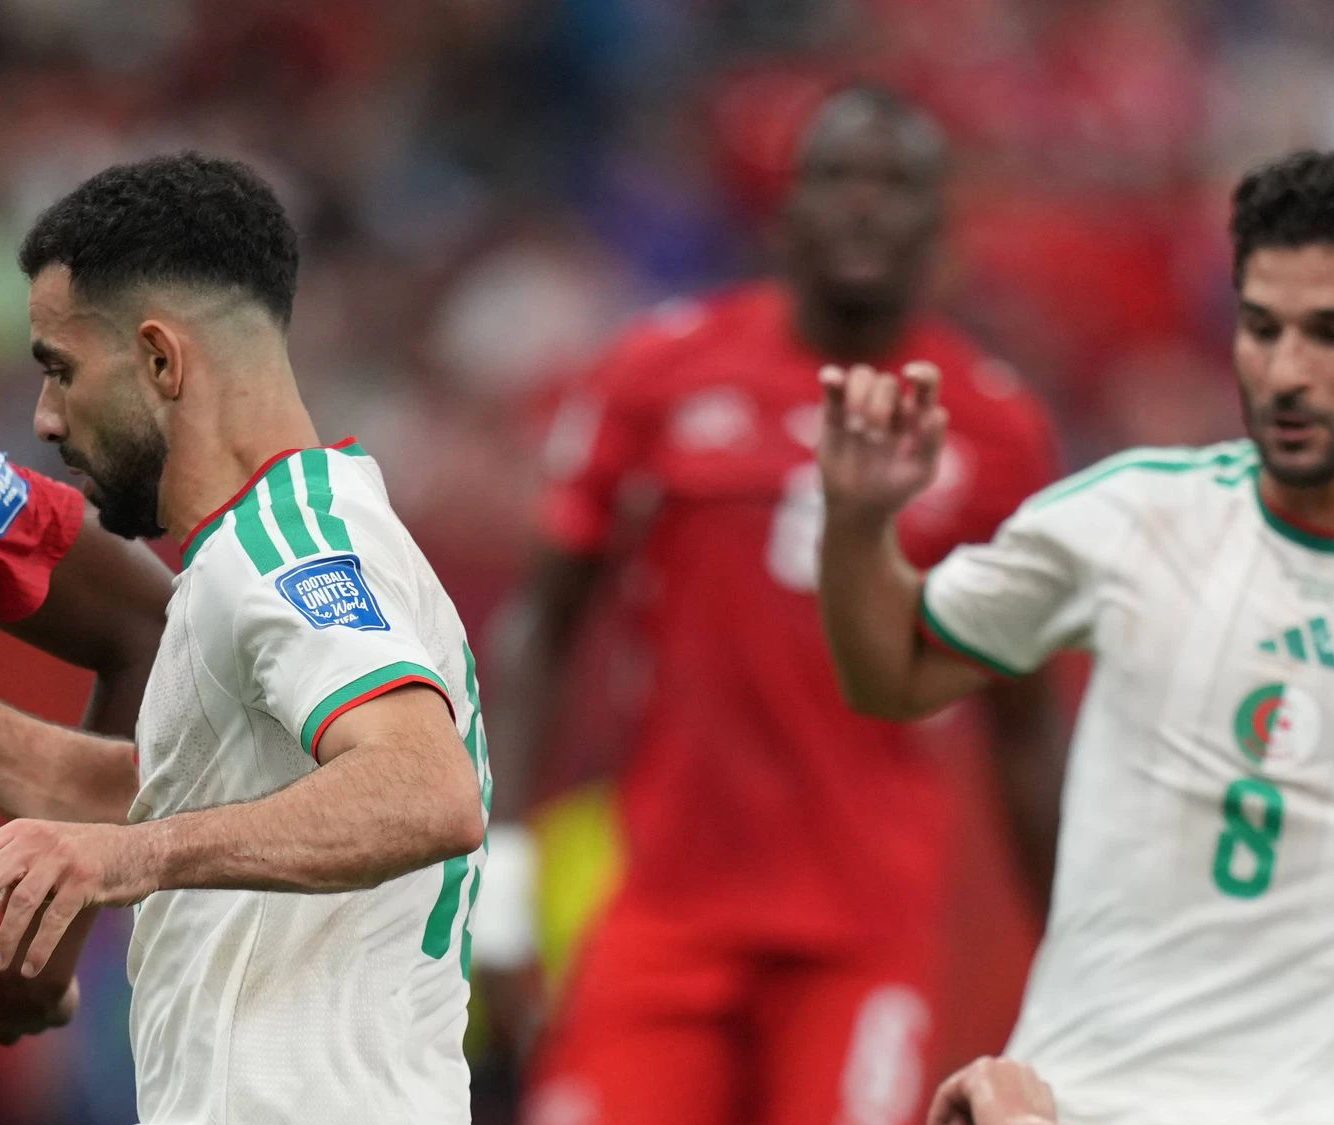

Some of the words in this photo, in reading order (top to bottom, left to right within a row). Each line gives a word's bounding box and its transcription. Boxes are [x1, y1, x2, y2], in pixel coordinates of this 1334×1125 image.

[295, 570, 352, 595] FOOTBALL
[302, 581, 359, 610] UNITES
[331, 597, 369, 617] World
[1211, 777, 1285, 900] 8
